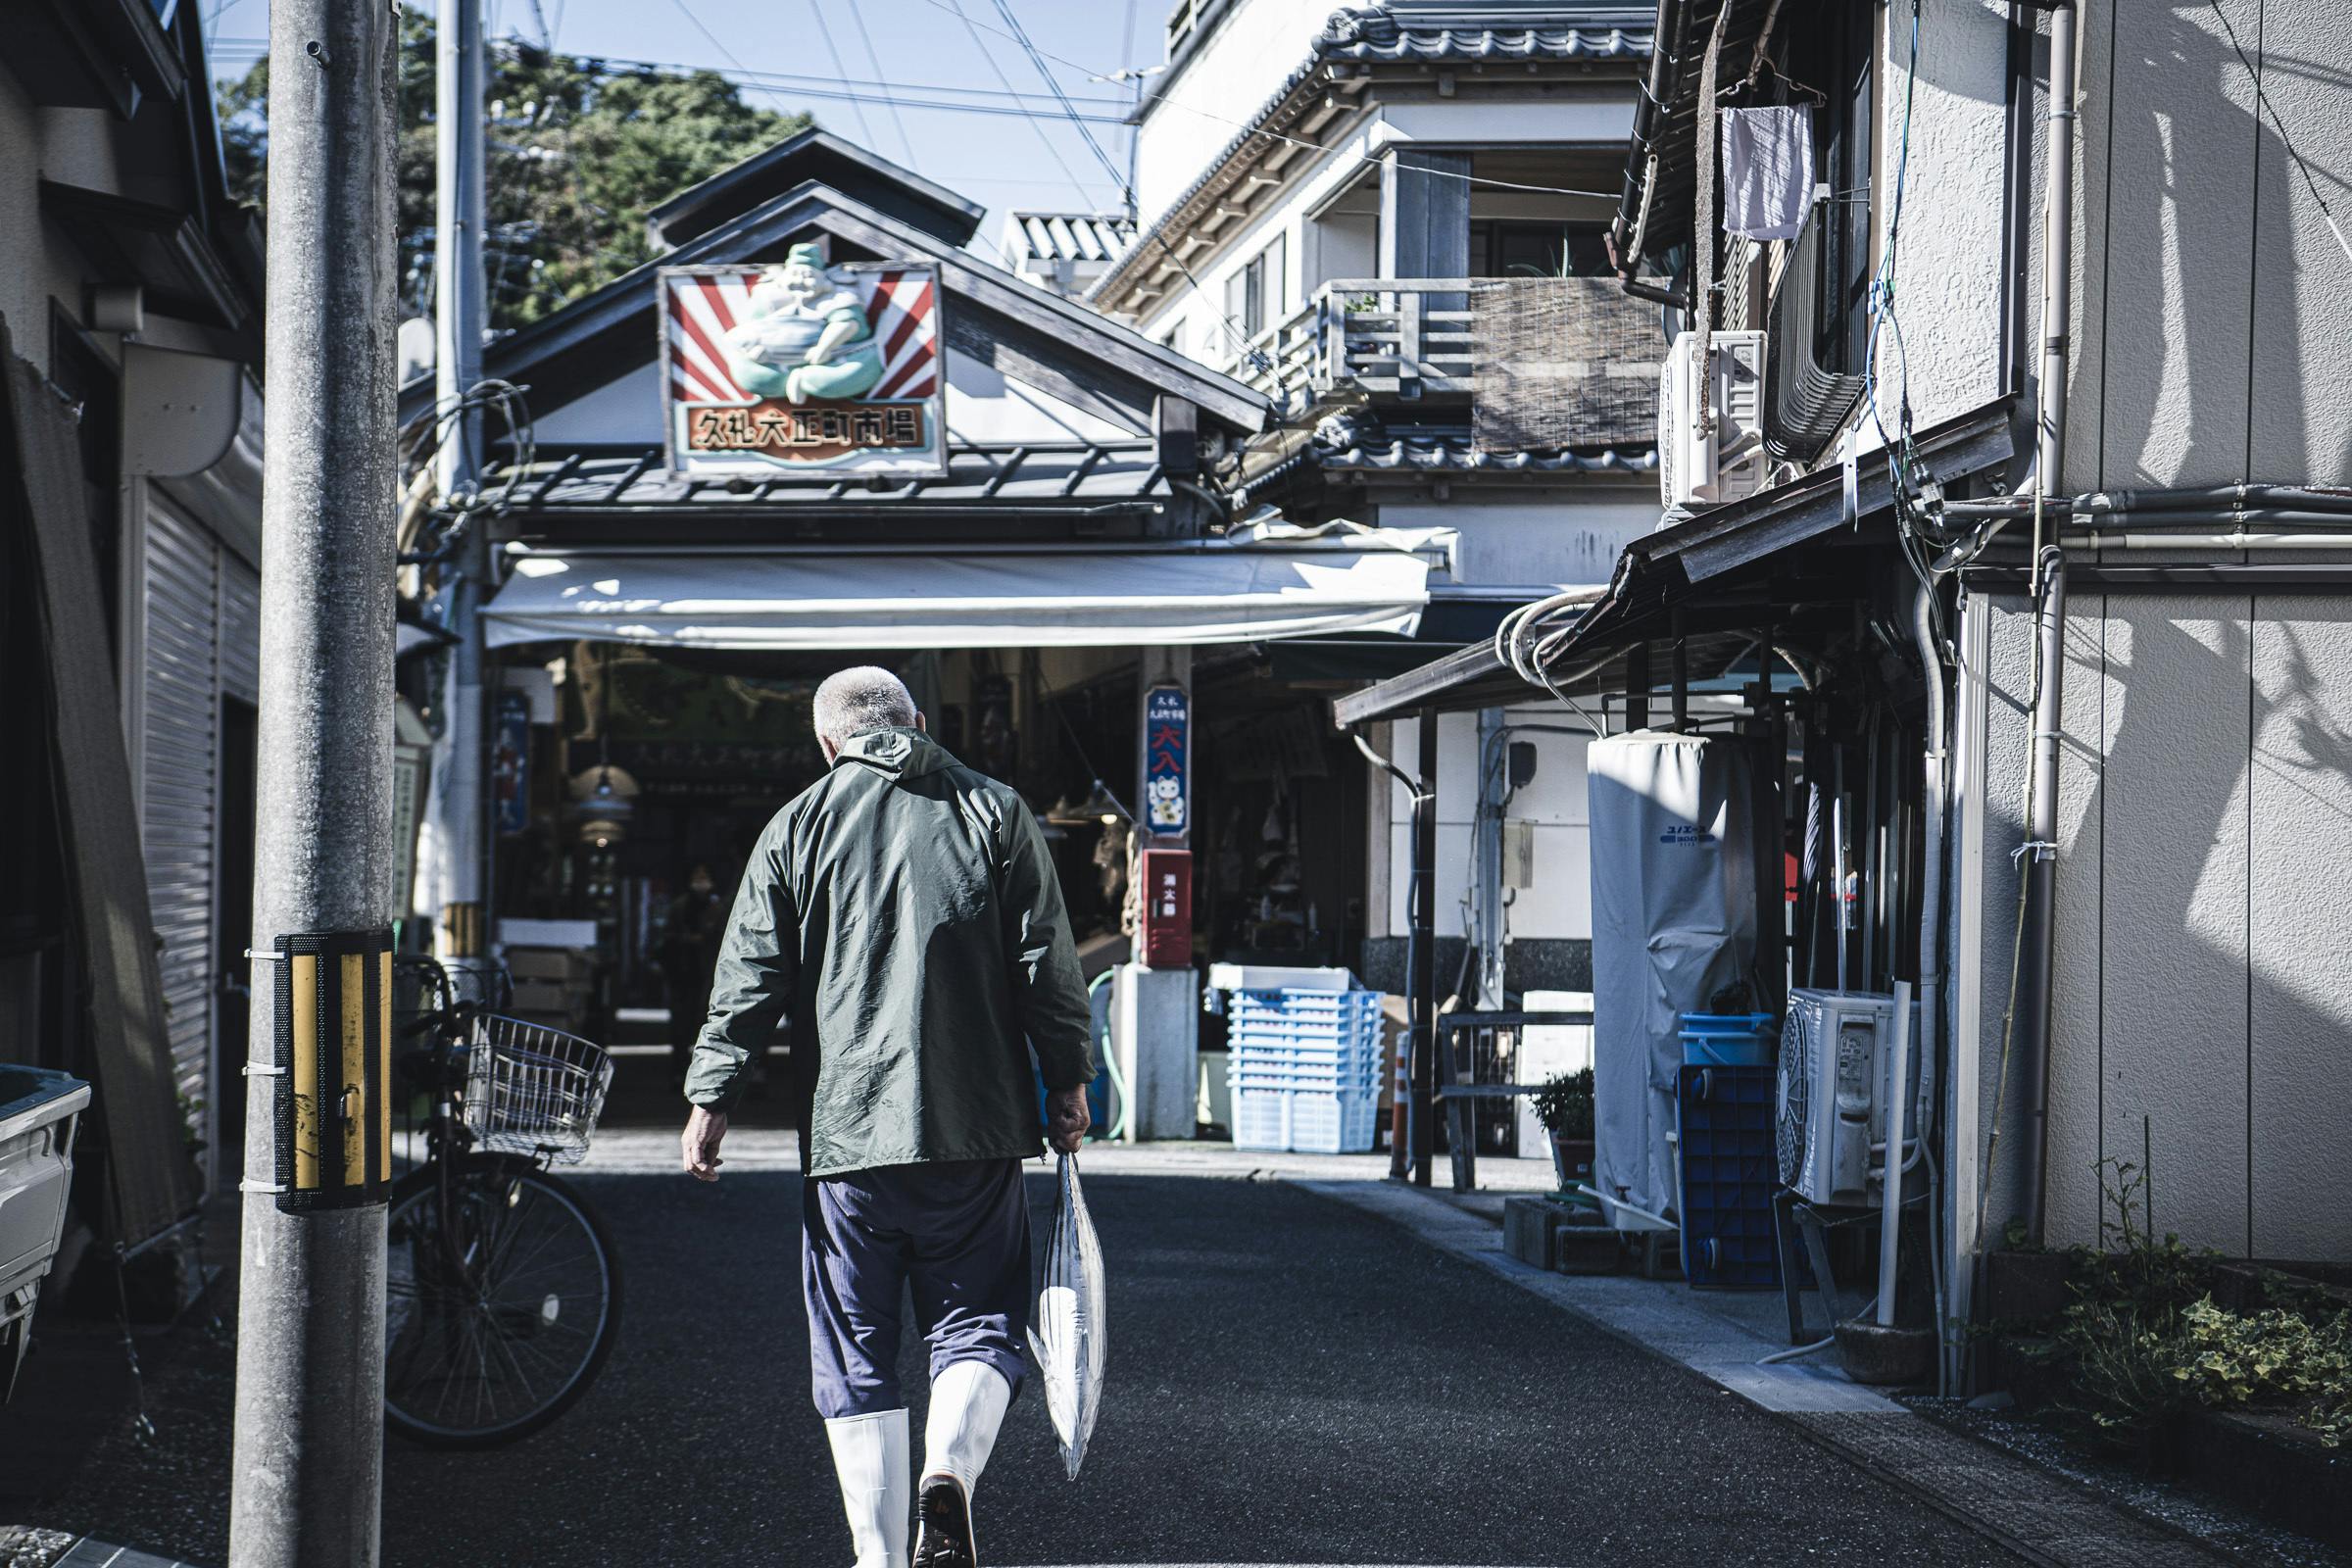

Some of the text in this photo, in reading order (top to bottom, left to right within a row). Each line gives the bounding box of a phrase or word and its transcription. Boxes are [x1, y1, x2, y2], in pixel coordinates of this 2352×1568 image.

[693, 408, 918, 447] 久礼大正町市場
[1162, 873, 1177, 916] 消火器
